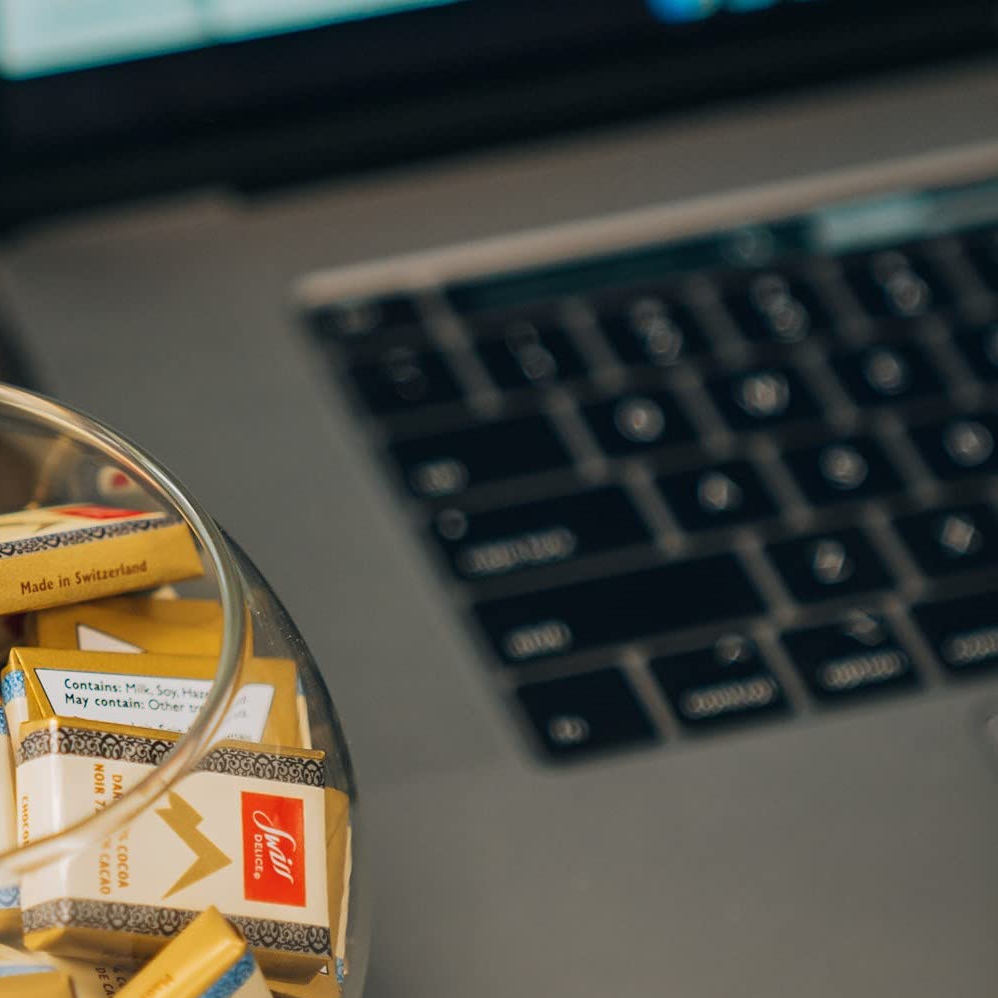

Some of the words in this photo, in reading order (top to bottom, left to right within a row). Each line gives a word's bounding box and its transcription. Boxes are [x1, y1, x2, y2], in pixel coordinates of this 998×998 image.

[20, 578, 54, 595] Made
[58, 574, 71, 588] in
[75, 560, 148, 585] Switzerland
[64, 678, 122, 694] Contains:
[65, 693, 88, 709] May
[94, 698, 145, 711] contain:
[148, 699, 184, 713] Other
[94, 763, 105, 794] NOIR
[112, 773, 123, 801] DAR
[252, 810, 297, 885] Swiss
[254, 833, 263, 873] DELICE
[98, 852, 111, 896] CACAO
[117, 844, 130, 888] COCOA
